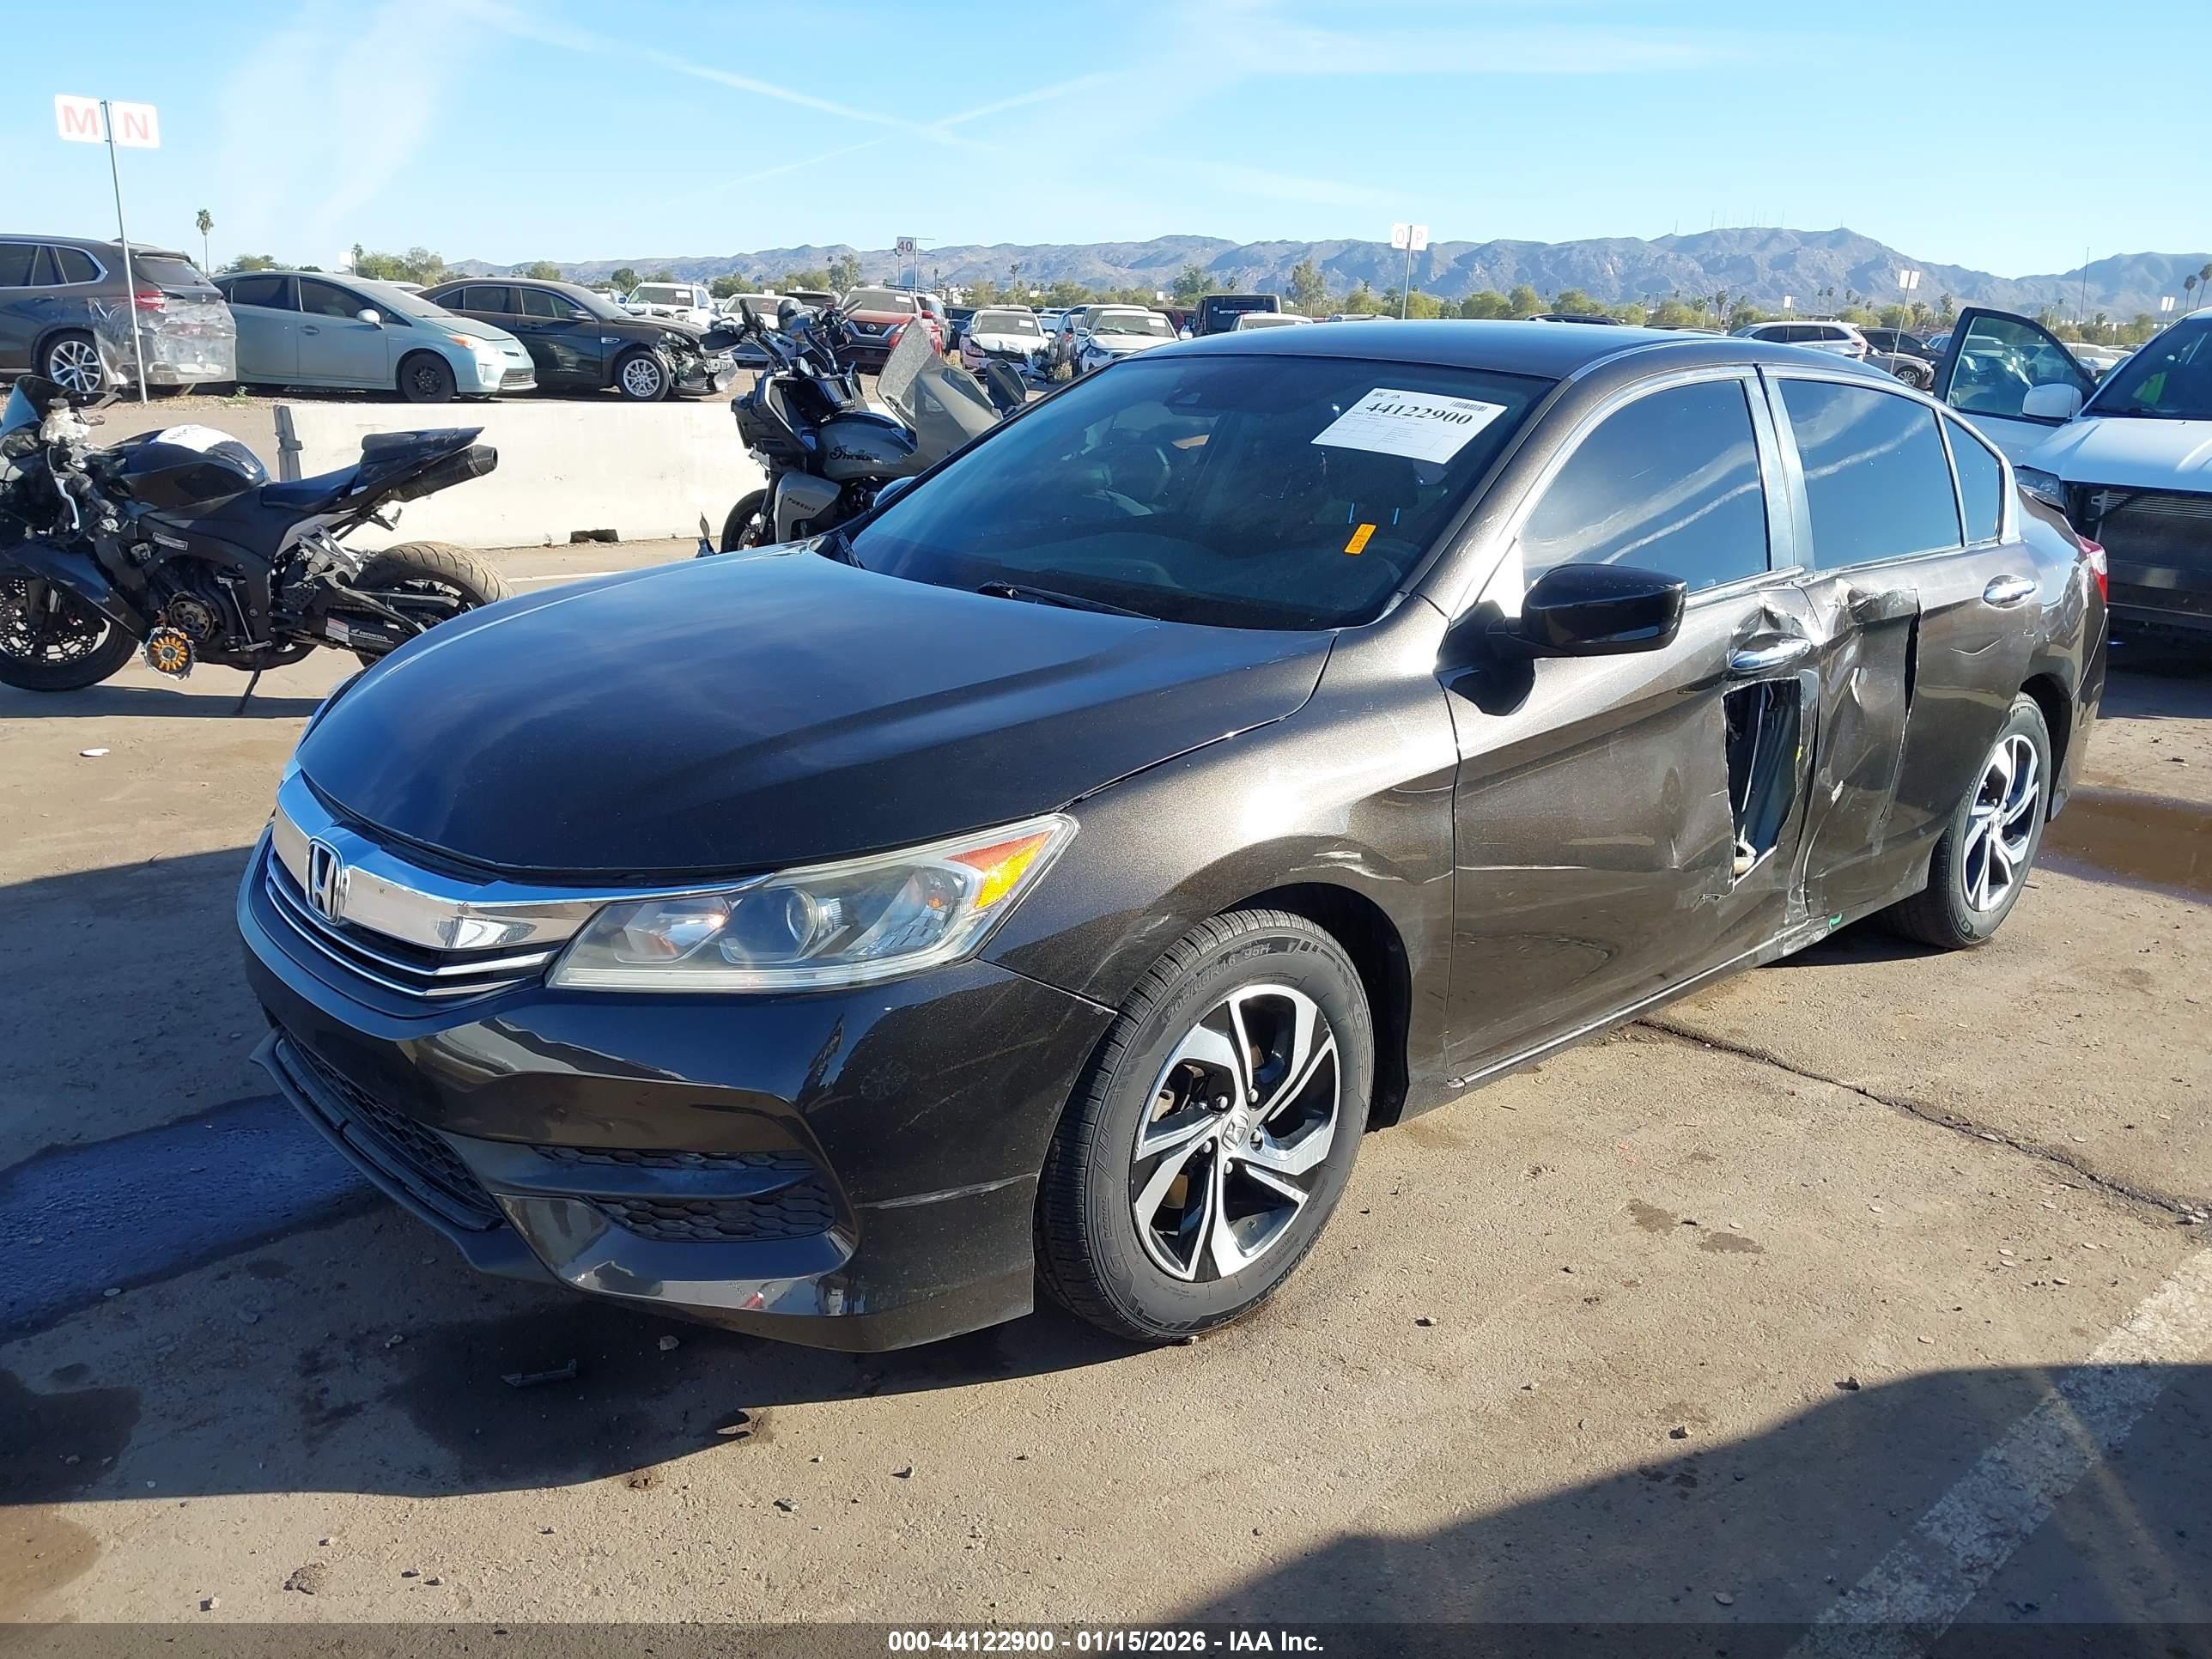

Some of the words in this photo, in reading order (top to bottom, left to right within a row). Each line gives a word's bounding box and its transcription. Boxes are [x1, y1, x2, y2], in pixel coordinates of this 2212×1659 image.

[63, 105, 98, 136] M
[123, 112, 149, 140] N
[897, 240, 913, 252] 40
[1366, 402, 1473, 425] 44122900
[359, 630, 388, 641] HONDA
